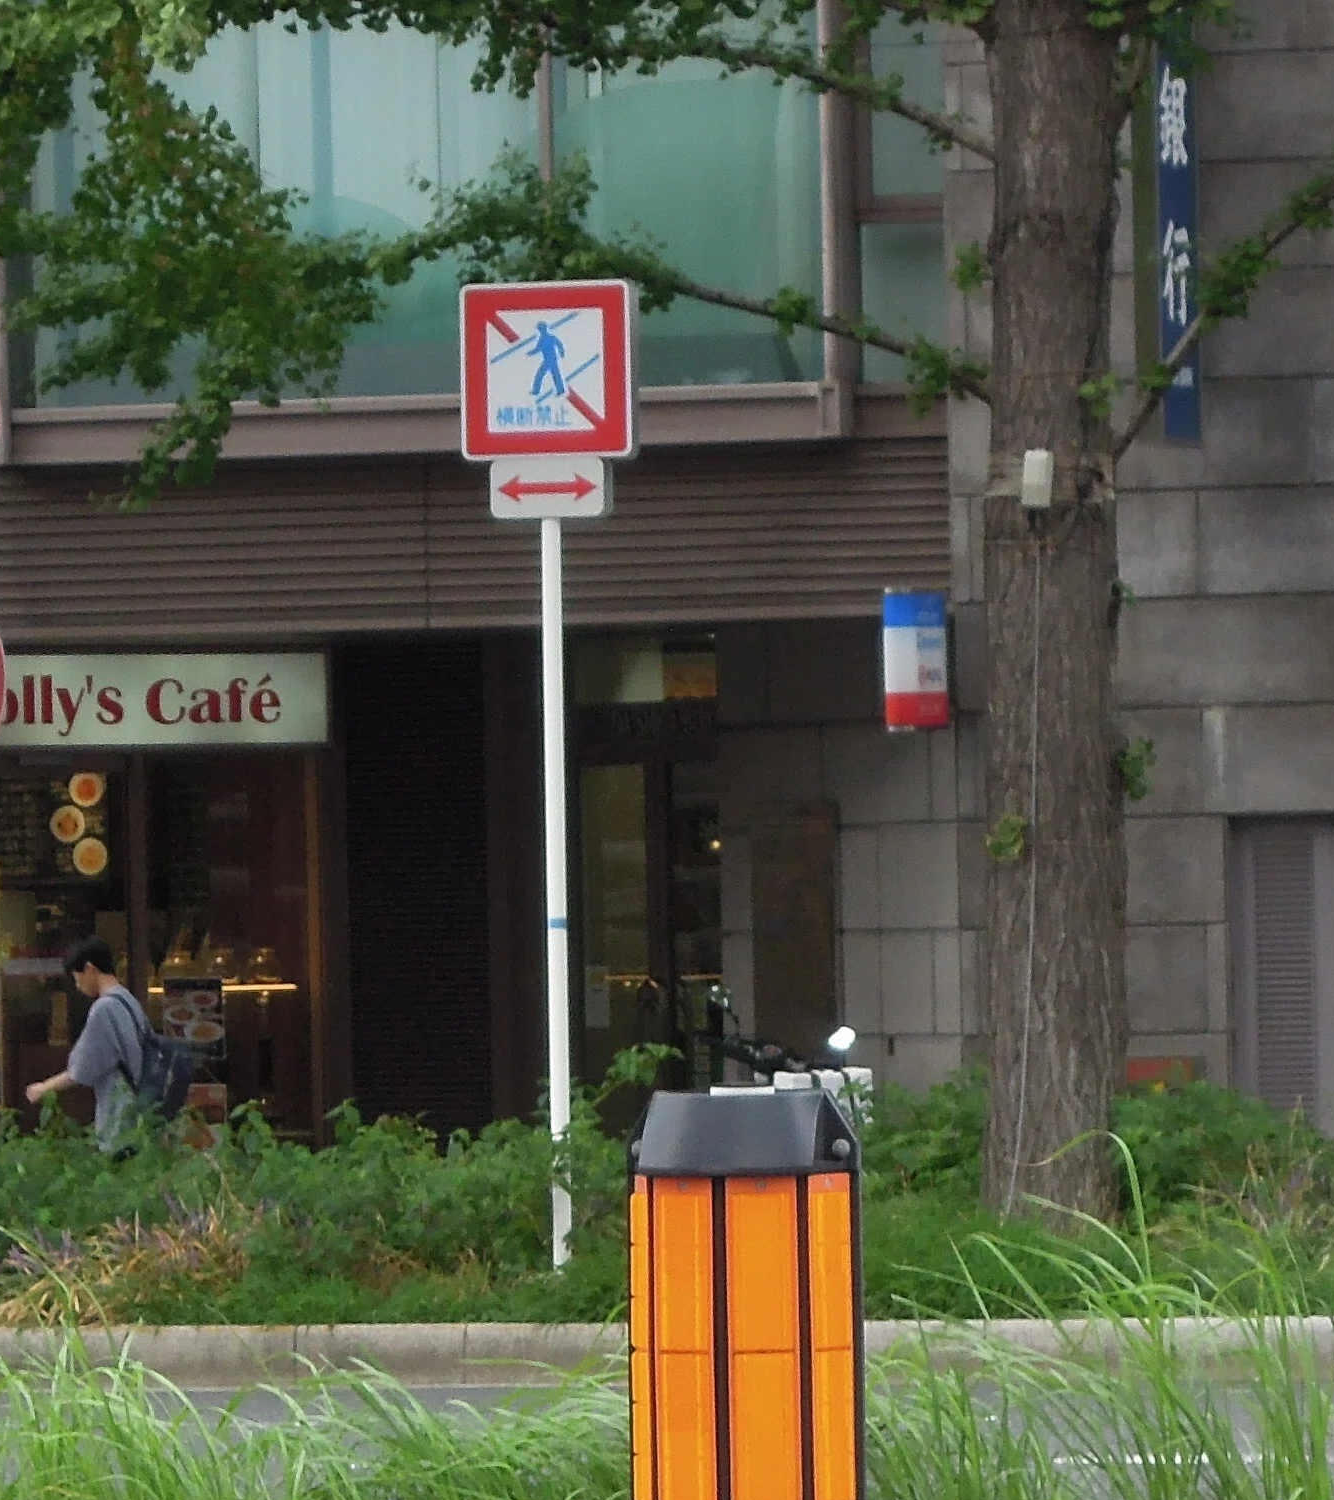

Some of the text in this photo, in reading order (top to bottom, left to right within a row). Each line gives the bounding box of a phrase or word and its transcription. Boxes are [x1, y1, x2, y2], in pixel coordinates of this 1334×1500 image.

[1160, 63, 1190, 326] 銀行
[496, 406, 571, 426] 横断禁止
[145, 674, 282, 725] Café
